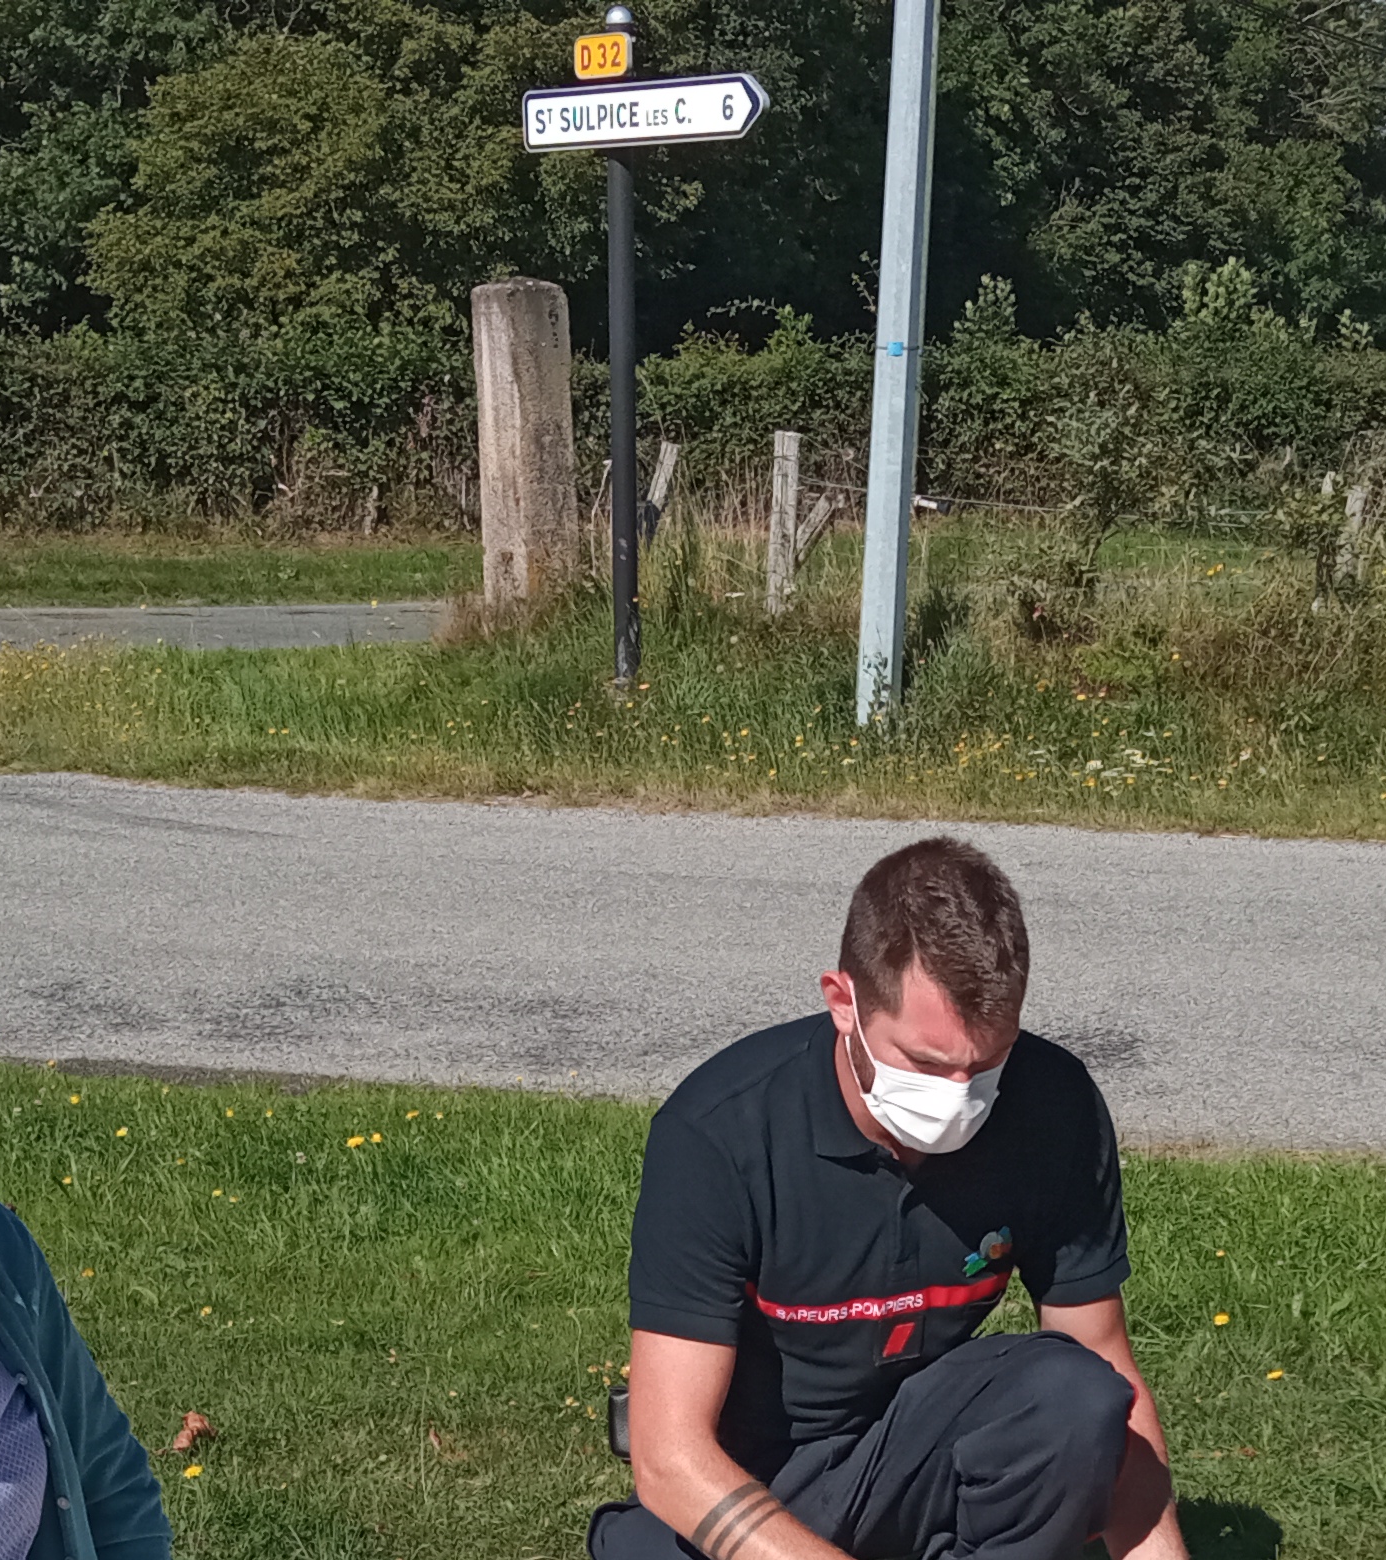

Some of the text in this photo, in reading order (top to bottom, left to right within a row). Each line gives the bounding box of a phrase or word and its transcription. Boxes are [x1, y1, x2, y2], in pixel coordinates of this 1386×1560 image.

[580, 41, 622, 71] D 32
[560, 101, 640, 133] SULPICE
[645, 109, 669, 128] LES
[674, 98, 692, 125] C.
[721, 94, 735, 121] 6
